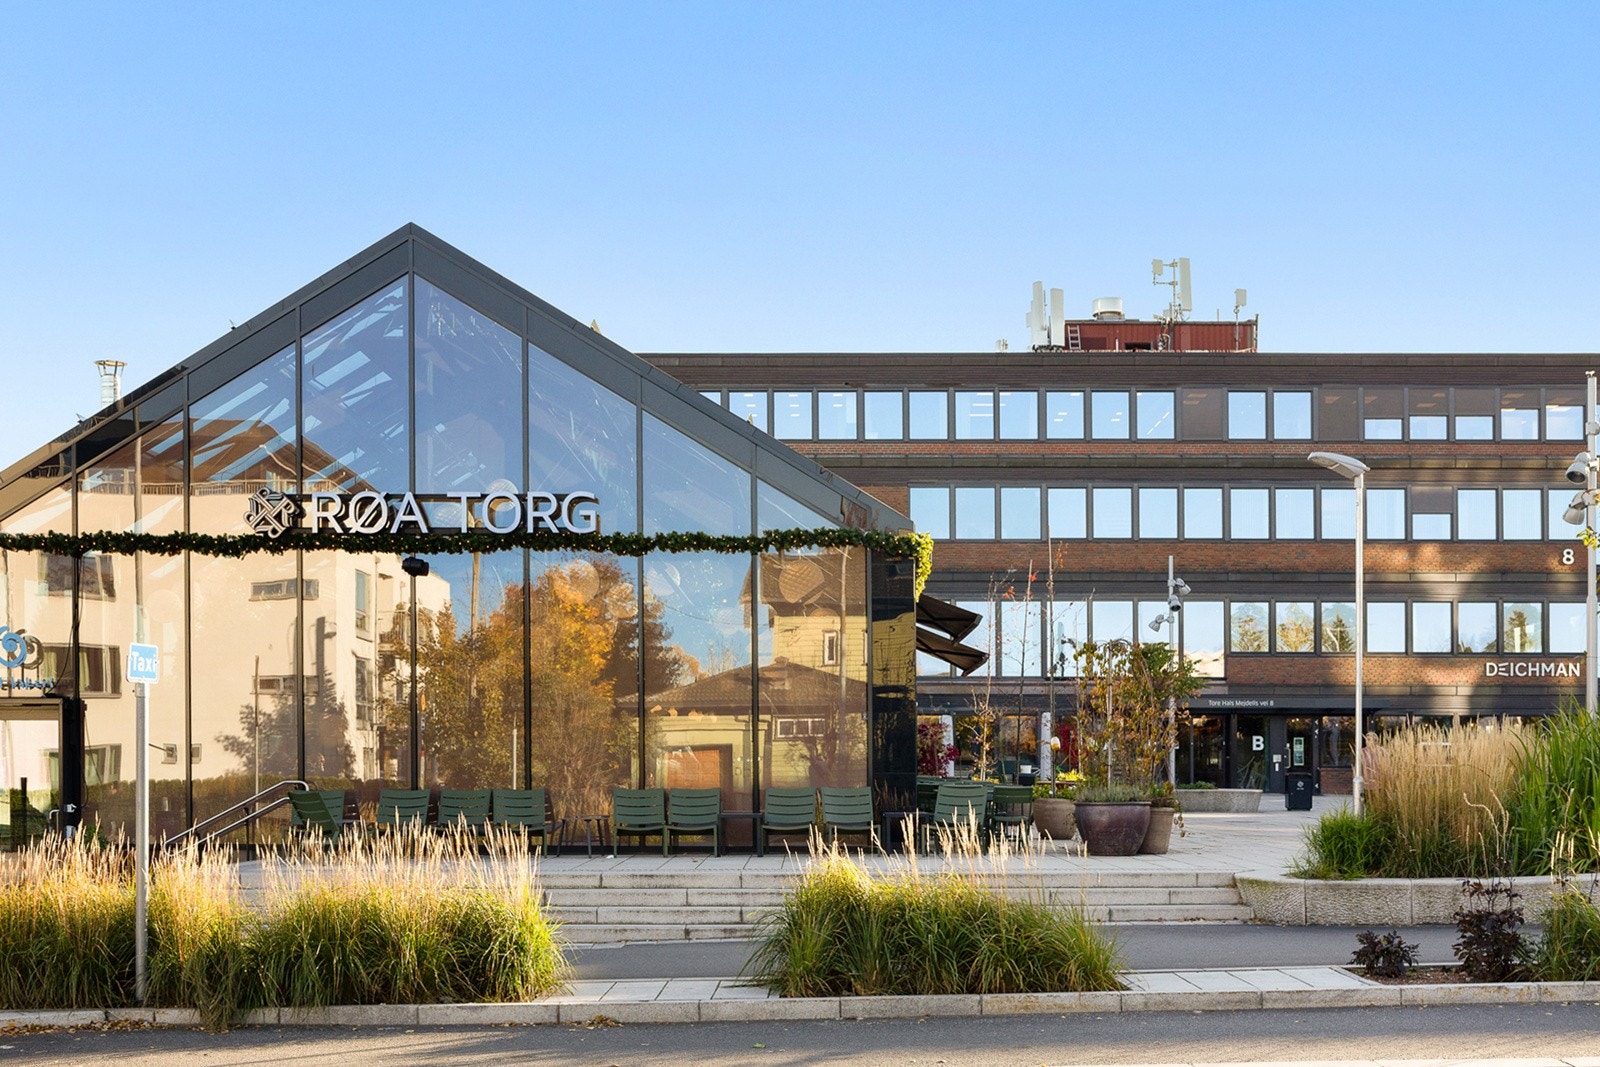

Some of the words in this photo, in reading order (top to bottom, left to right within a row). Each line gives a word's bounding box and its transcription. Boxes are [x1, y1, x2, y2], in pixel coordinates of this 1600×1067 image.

[311, 491, 429, 535] RØA
[446, 490, 598, 535] TORG
[1562, 548, 1575, 565] 8
[131, 651, 157, 673] Taxi
[1485, 662, 1580, 677] DEICHMAN
[1252, 735, 1265, 751] B
